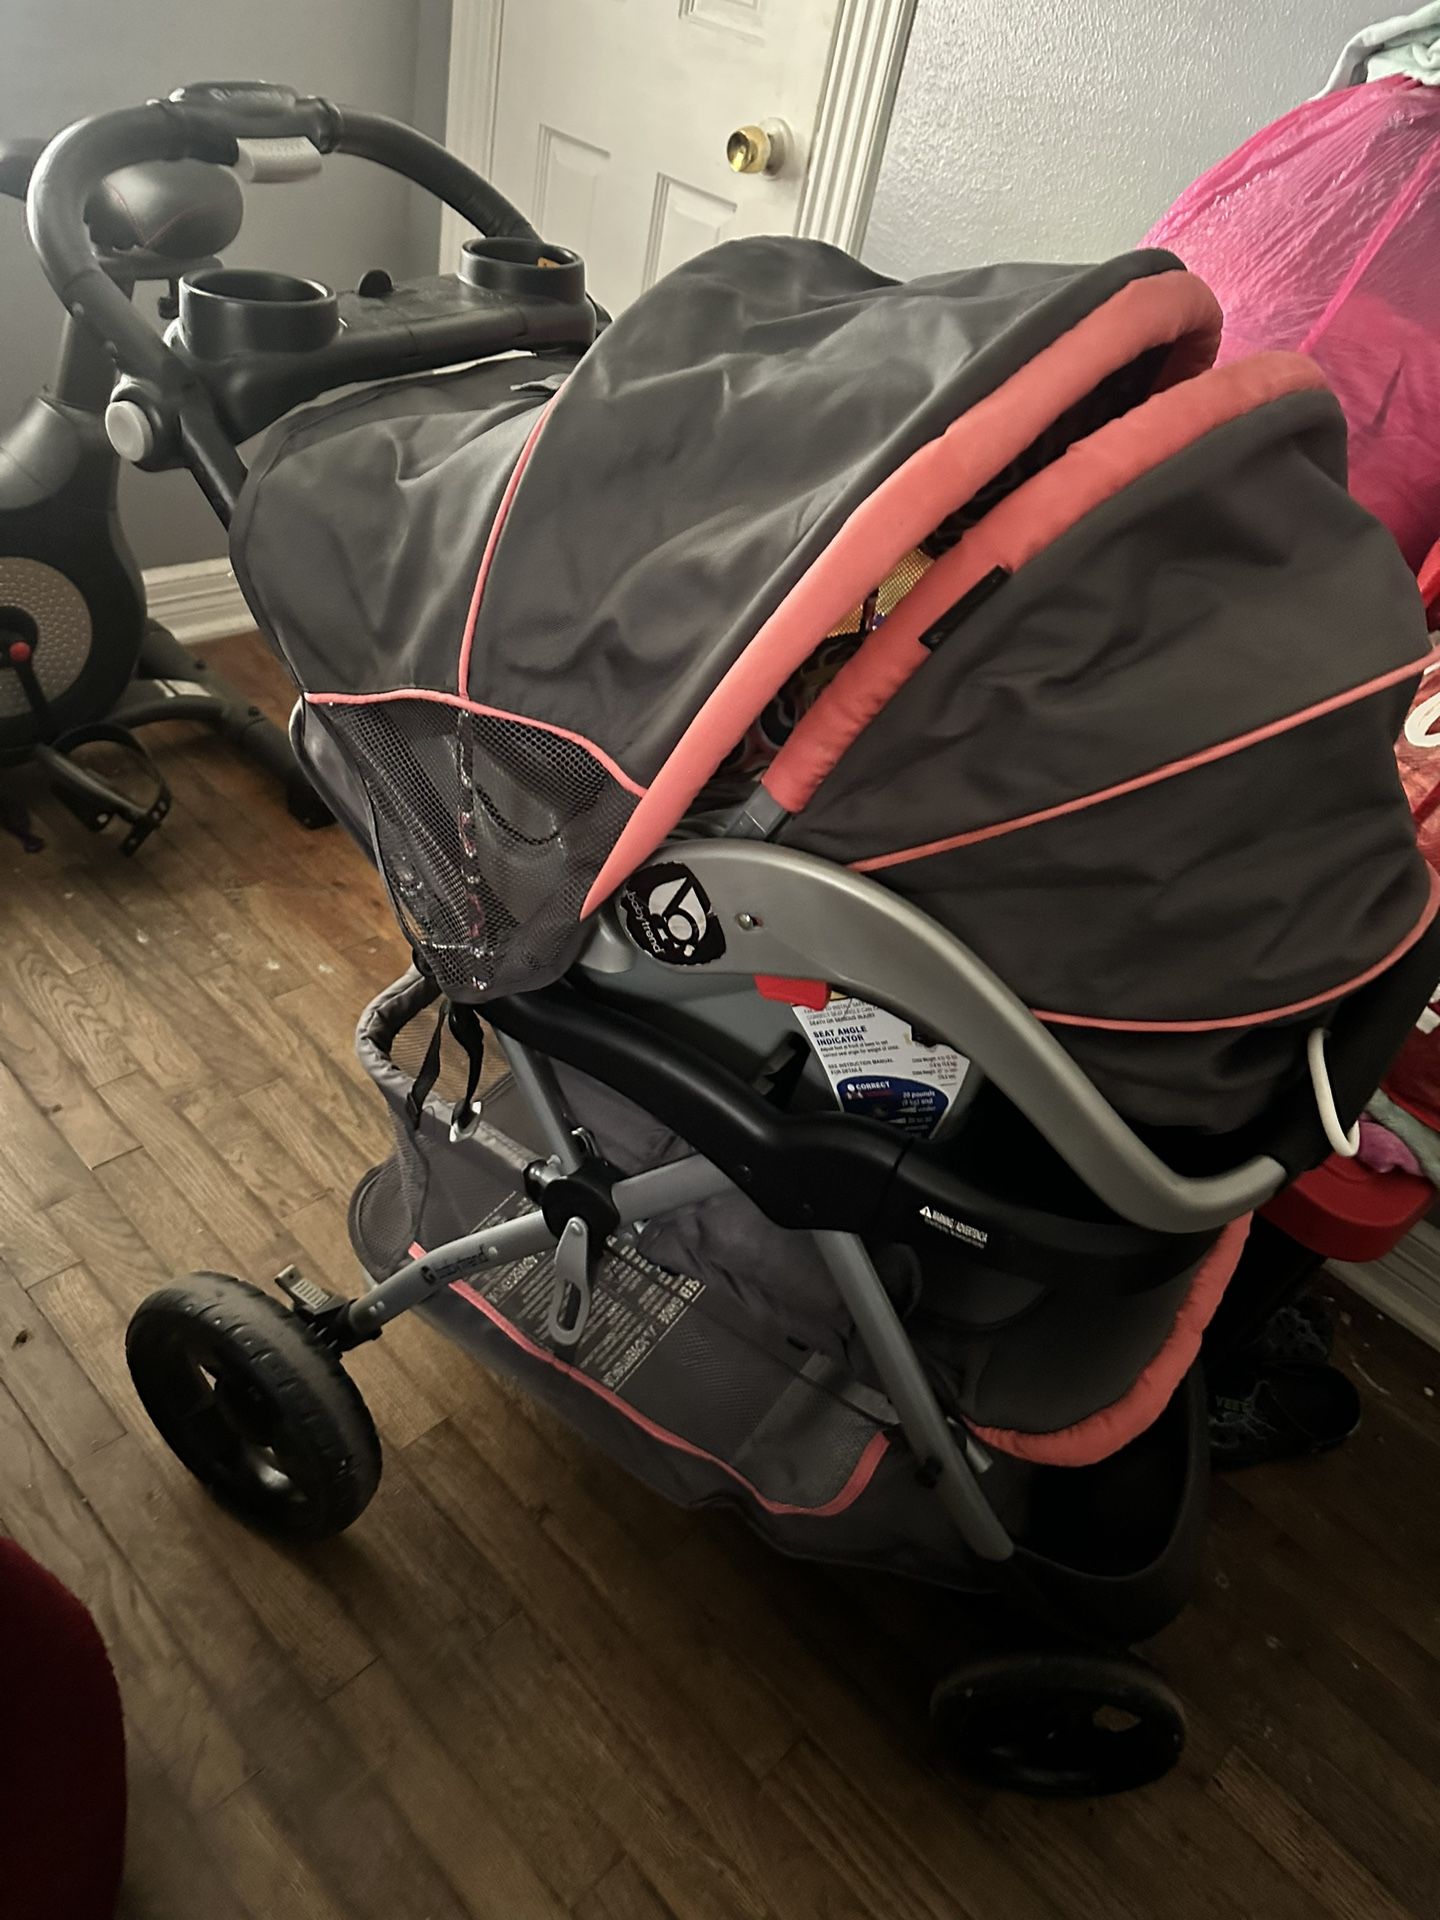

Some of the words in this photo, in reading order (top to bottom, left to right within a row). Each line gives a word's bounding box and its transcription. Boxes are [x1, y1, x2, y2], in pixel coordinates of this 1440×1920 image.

[813, 1028, 835, 1038] SEAT
[837, 1025, 867, 1036] ANGLE
[816, 1035, 865, 1046] INDICATOR
[855, 1080, 891, 1090] CORRECT
